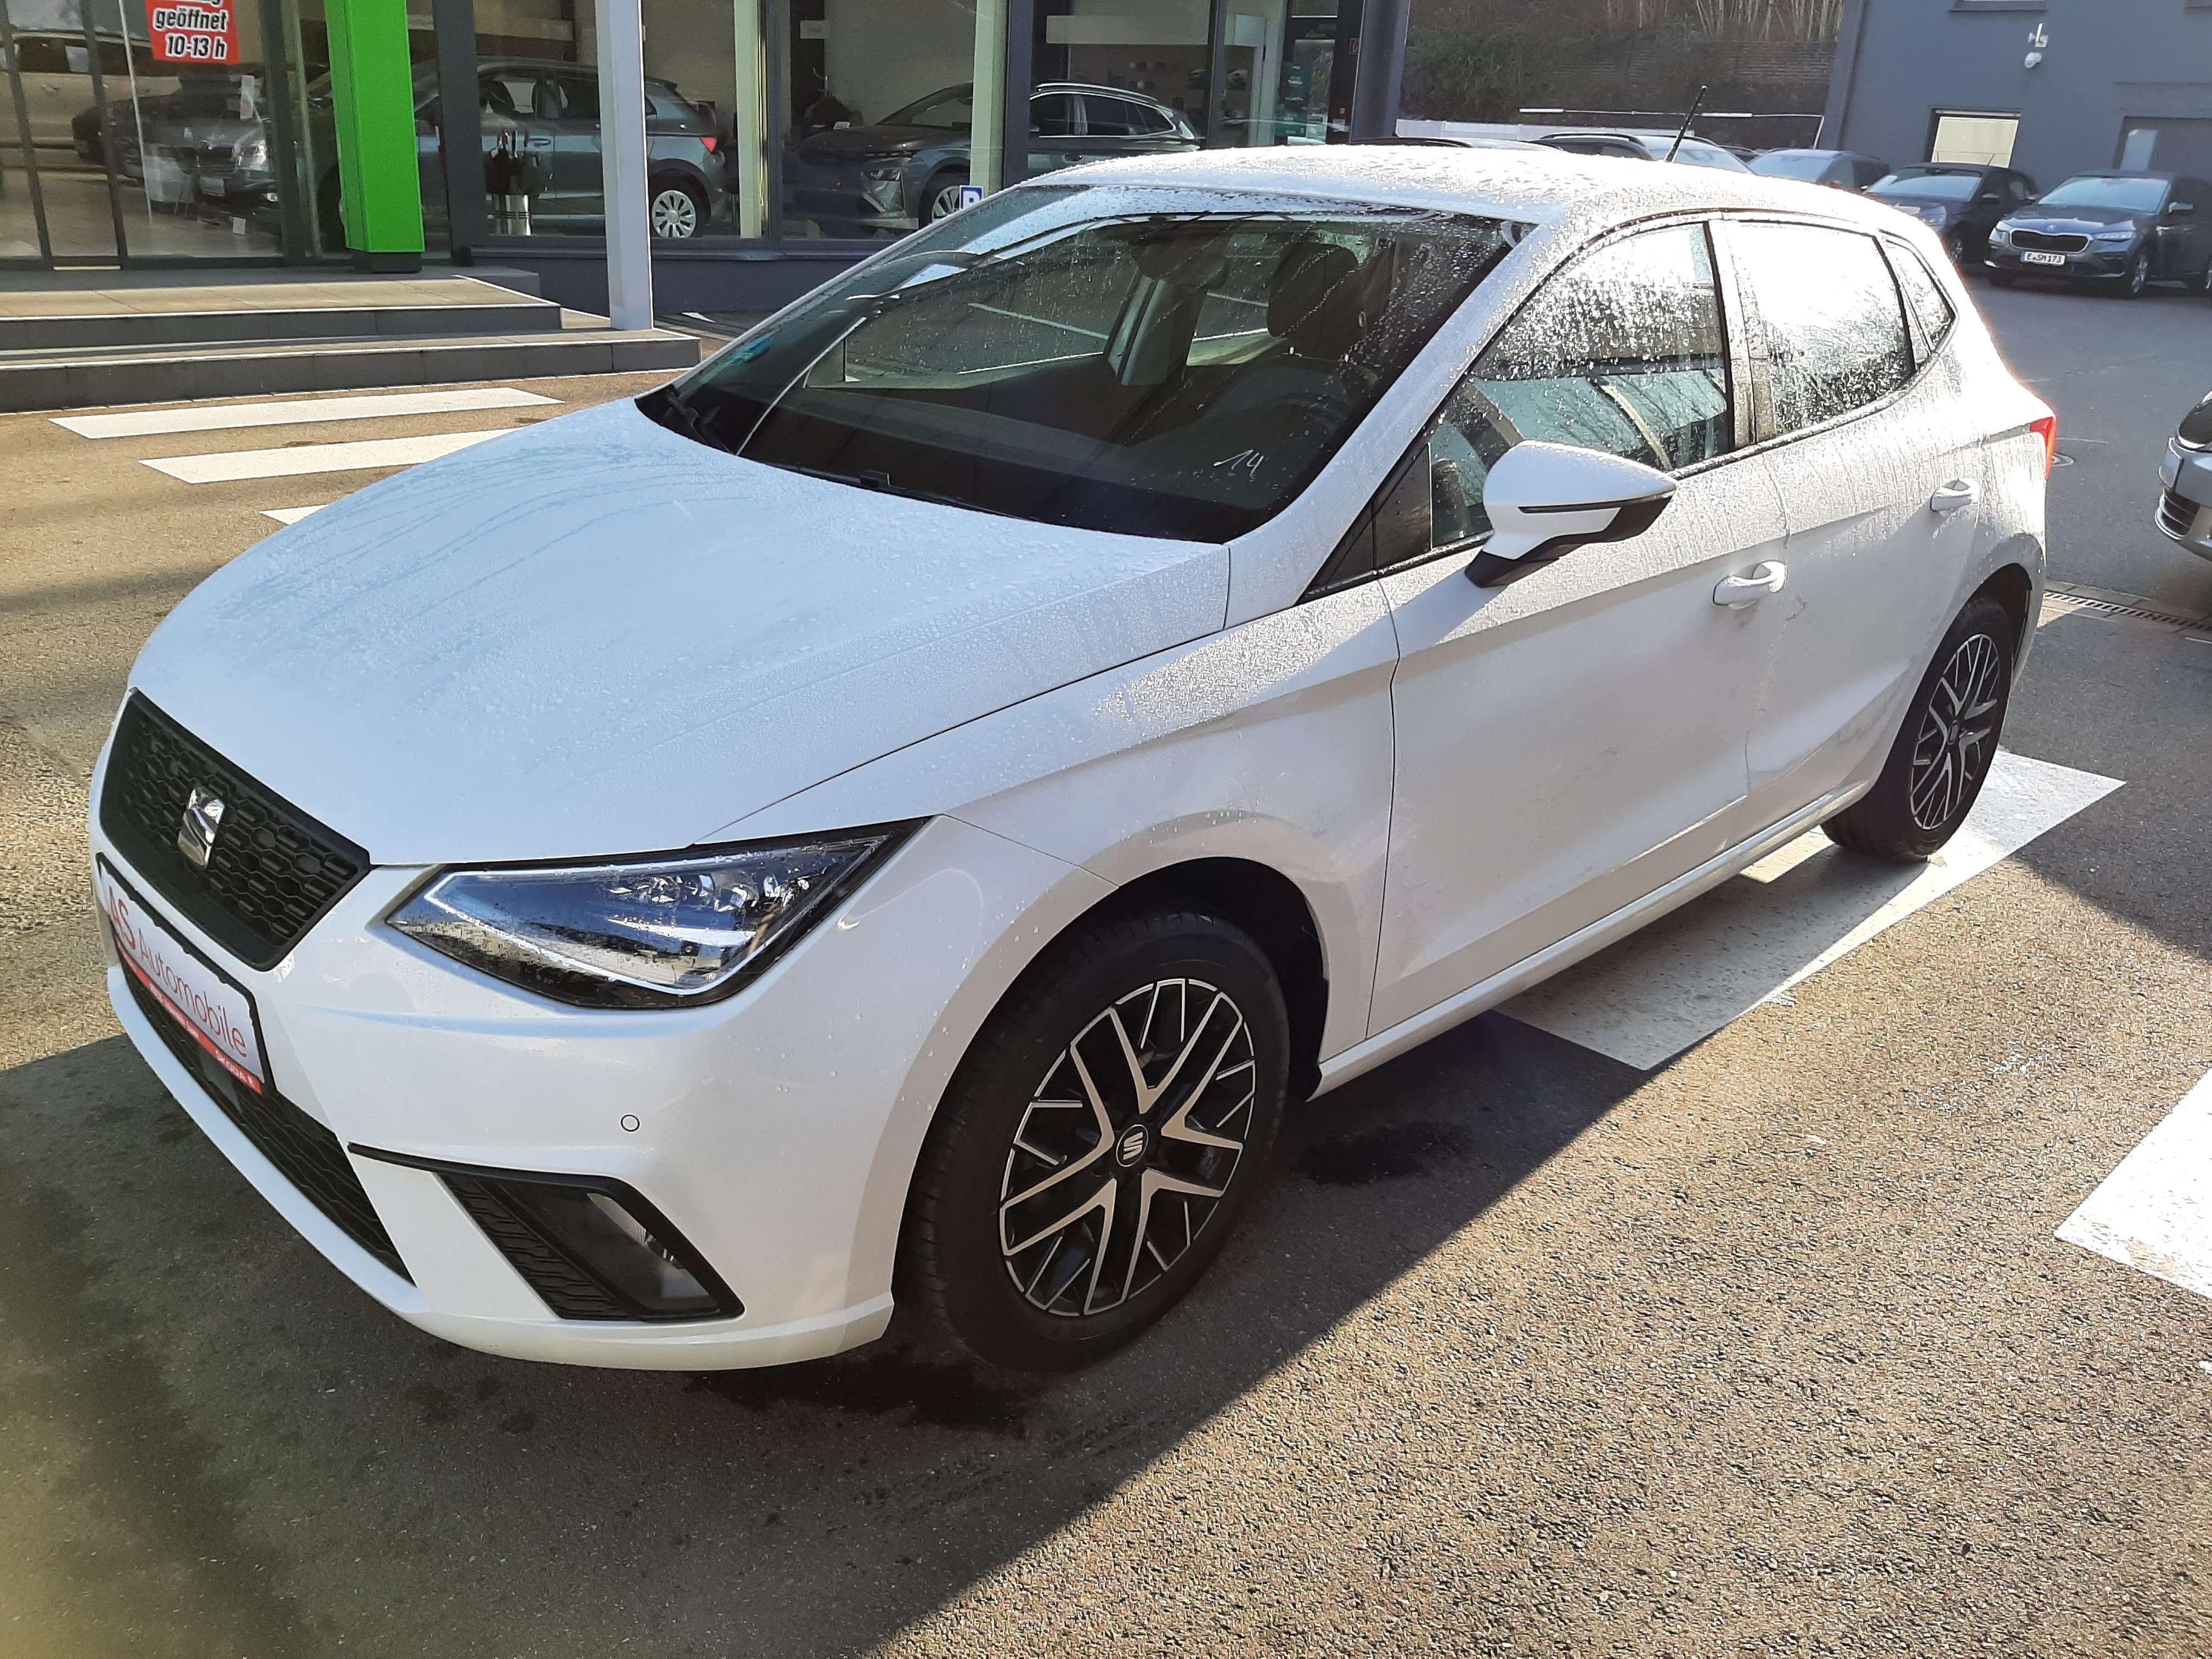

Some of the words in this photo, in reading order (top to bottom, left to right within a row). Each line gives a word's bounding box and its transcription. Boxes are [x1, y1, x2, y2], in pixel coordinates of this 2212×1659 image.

[156, 8, 227, 29] geöffnet
[167, 35, 209, 56] 10-13
[215, 39, 224, 57] h
[109, 885, 136, 950] AS
[139, 928, 247, 1057] Automobile
